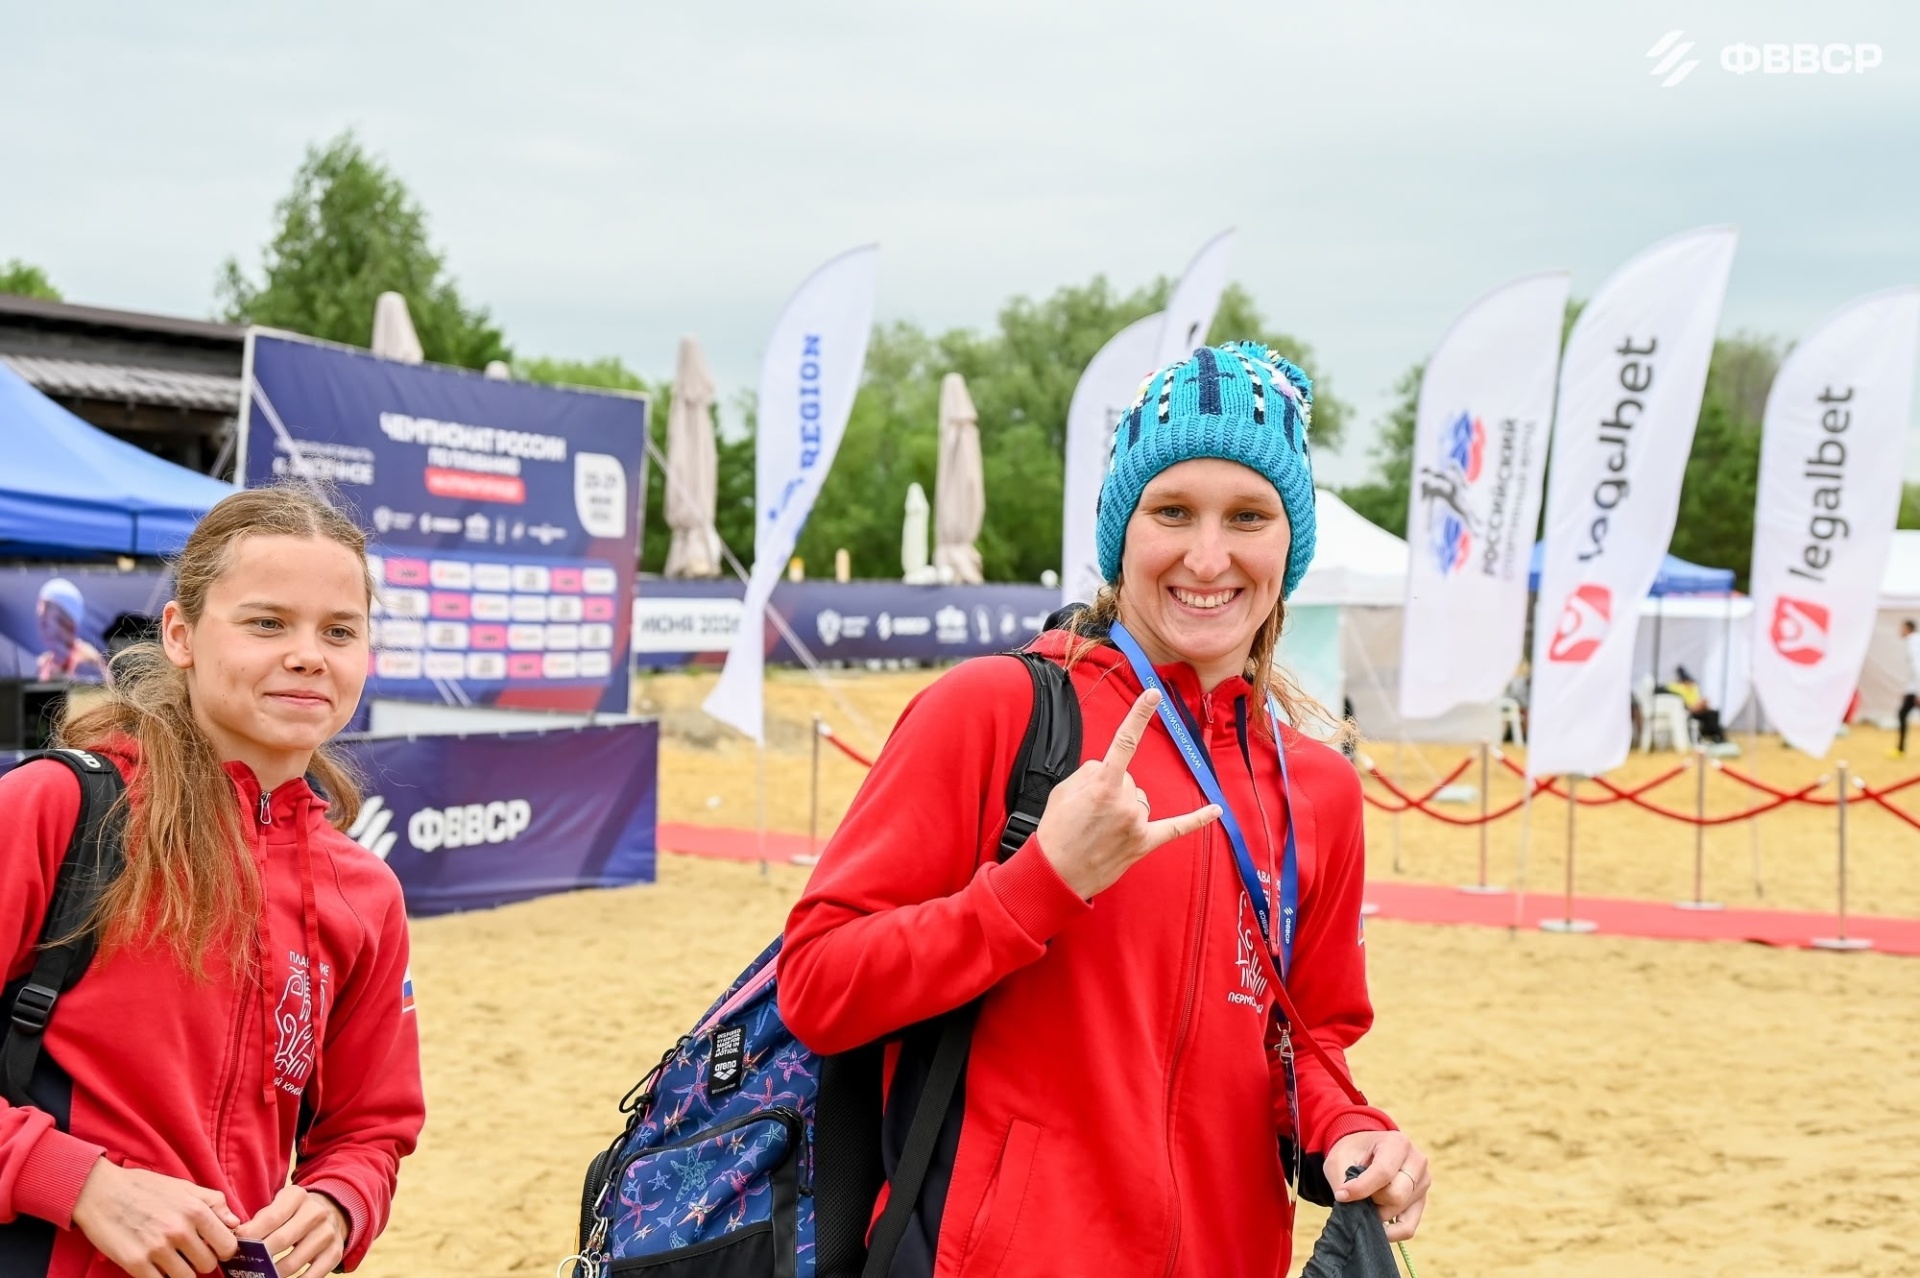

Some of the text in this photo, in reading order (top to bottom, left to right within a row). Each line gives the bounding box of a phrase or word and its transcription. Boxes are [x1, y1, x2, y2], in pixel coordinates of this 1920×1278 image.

[1788, 385, 1855, 583] legalbet
[408, 799, 532, 853] ФВВСР
[714, 1060, 737, 1072] arena
